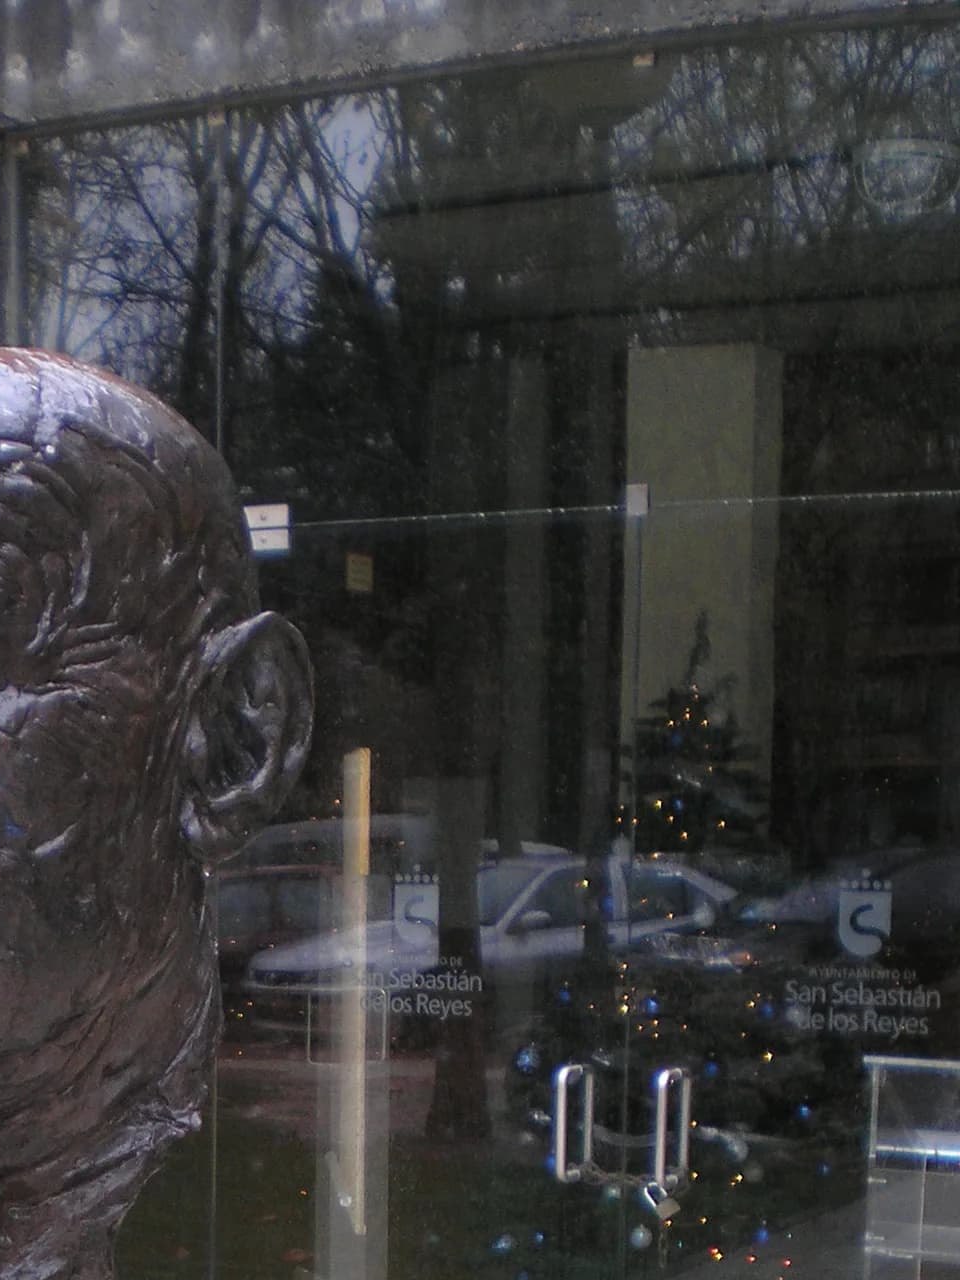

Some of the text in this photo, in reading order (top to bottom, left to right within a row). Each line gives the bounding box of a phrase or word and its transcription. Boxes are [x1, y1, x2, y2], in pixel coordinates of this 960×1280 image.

[389, 967, 483, 992] Sebastián
[785, 979, 941, 1010] San Sebastián
[387, 989, 413, 1015] los
[416, 993, 473, 1021] Reyes
[828, 1006, 859, 1033] los
[863, 1008, 929, 1040] Reyes
